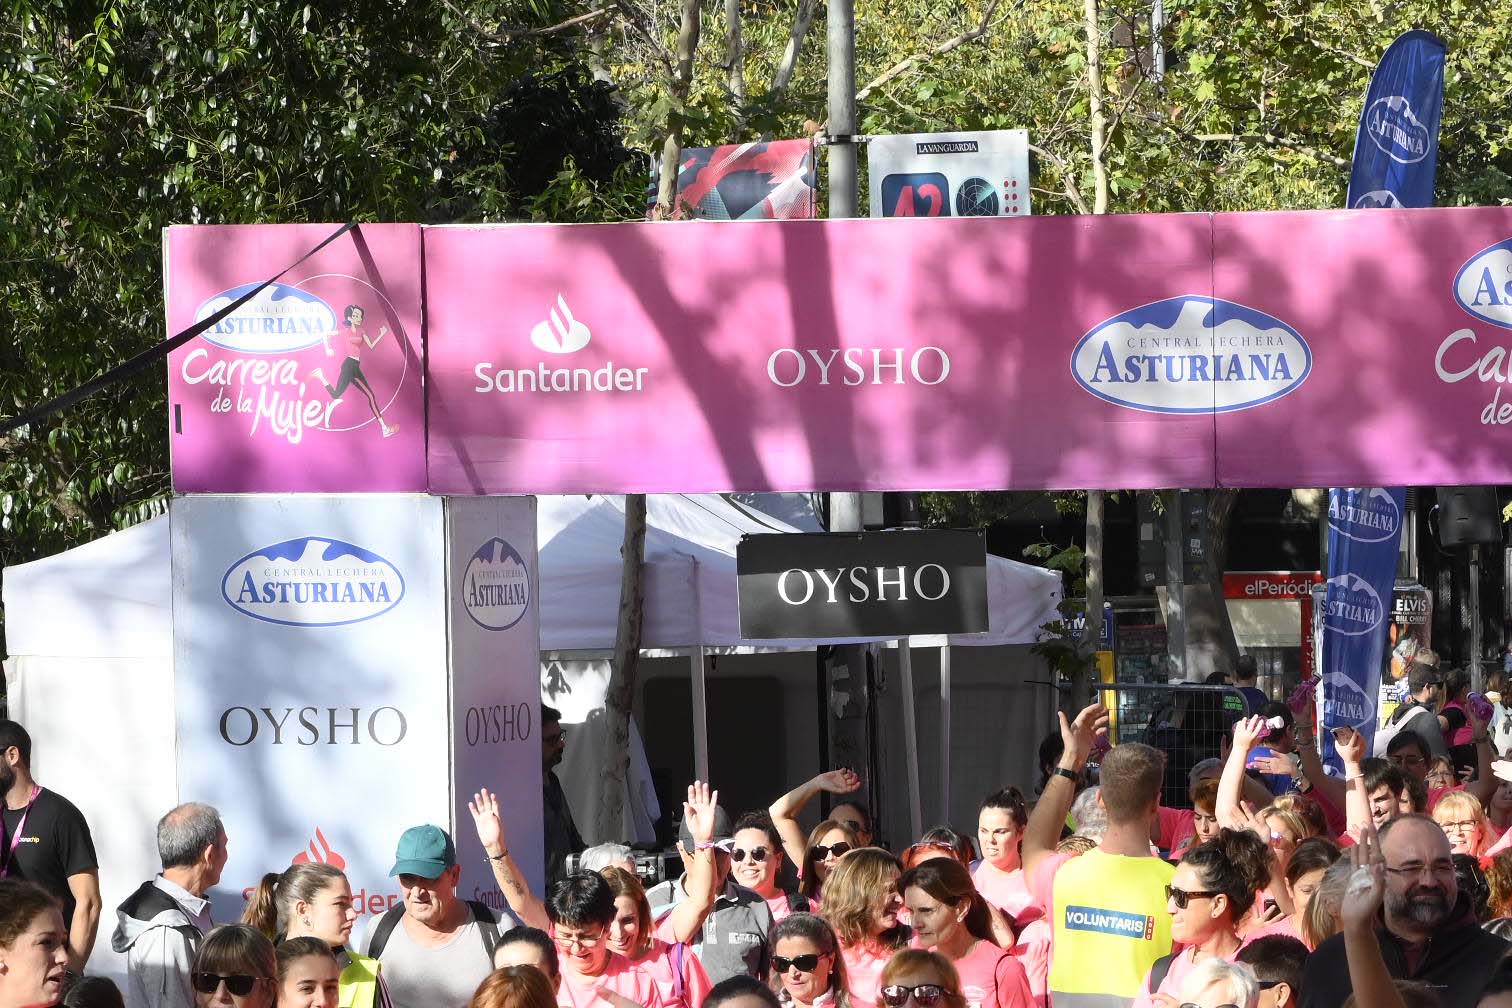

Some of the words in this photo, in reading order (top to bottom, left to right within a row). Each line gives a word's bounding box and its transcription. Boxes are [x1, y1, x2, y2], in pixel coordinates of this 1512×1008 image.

[1126, 335, 1201, 348] CENTRAL
[1210, 334, 1286, 347] LECHERA
[181, 348, 299, 386] Carrera
[475, 362, 648, 393] Santander
[766, 345, 951, 388] OYSHO
[1091, 339, 1293, 384] ASTURIANA
[211, 387, 233, 412] de
[237, 386, 253, 412] la
[250, 384, 344, 444] Mujer
[236, 570, 392, 604] ASTURIANA
[264, 568, 321, 577] CENTRAL
[327, 567, 385, 577] LECHERA
[777, 564, 951, 605] OYSHO
[468, 573, 526, 608] ASTURIANA
[1396, 599, 1427, 612] ELVIS
[219, 706, 408, 747] OYSHO
[465, 702, 531, 747] OYSHO
[1066, 911, 1144, 933] VOLUNTARIS
